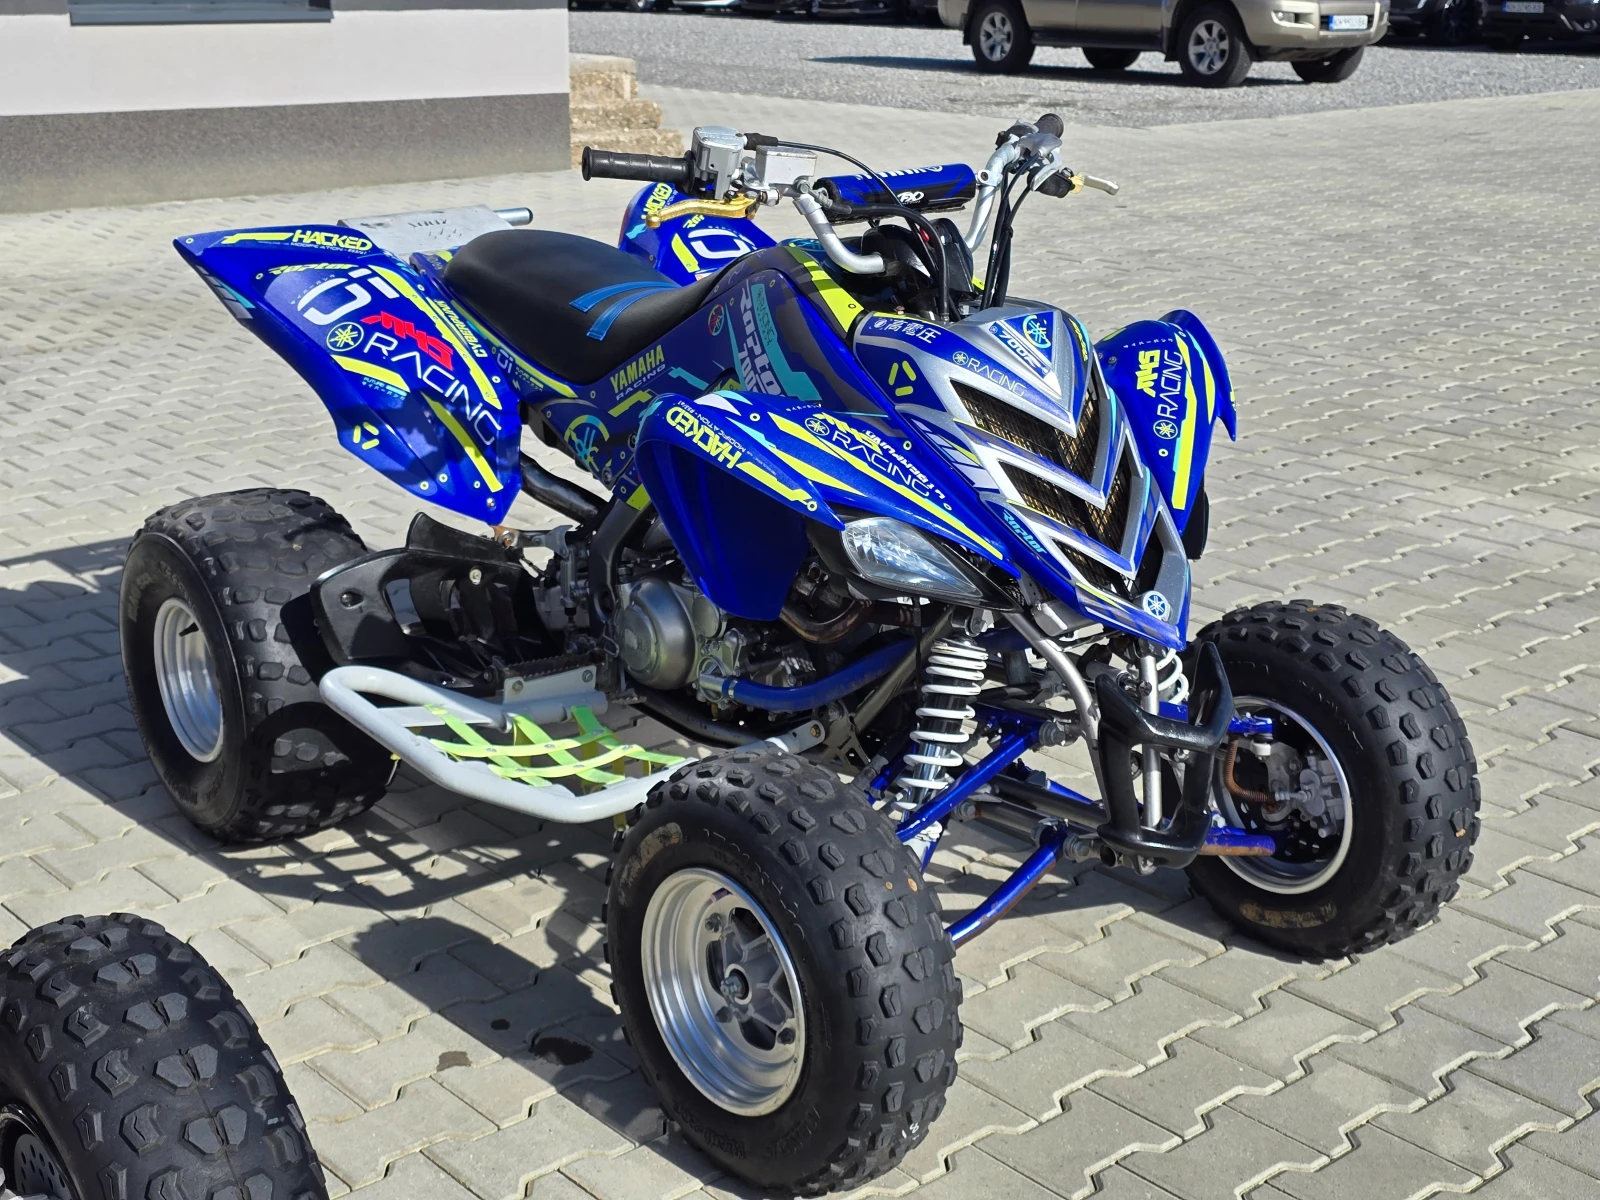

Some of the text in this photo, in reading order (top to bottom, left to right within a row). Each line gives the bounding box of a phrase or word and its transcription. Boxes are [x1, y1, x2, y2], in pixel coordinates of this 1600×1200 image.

[292, 229, 373, 251] HACKED
[434, 298, 489, 358] CYBERPUNK
[740, 278, 787, 398] Rapto
[363, 332, 502, 446] RACING
[610, 344, 665, 393] YAMAHA
[615, 363, 666, 401] RACING
[967, 358, 1027, 398] RACING
[1157, 349, 1183, 420] RACING
[665, 406, 743, 469] HACKED
[832, 430, 930, 497] RACING
[1003, 509, 1047, 553] Raptor
